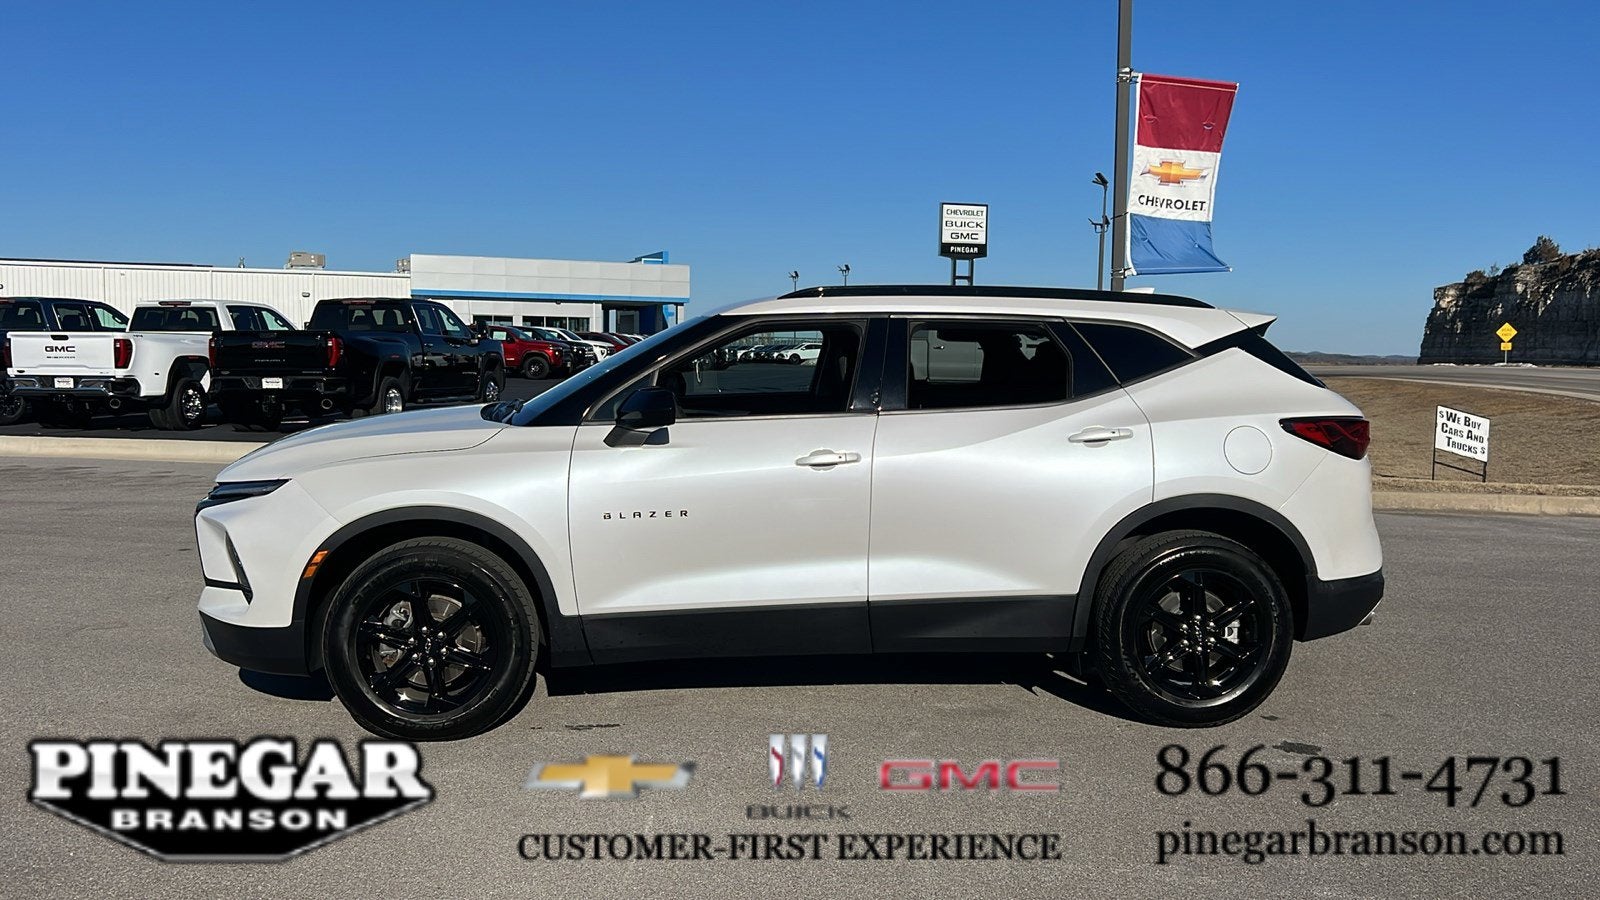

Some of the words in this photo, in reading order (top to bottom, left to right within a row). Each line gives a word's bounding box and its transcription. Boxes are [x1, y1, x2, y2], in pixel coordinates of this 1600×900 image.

[1138, 194, 1206, 212] CHEVROLET
[946, 208, 984, 217] CHEVROLET
[945, 220, 984, 229] BUICK
[950, 232, 979, 240] GMC
[950, 246, 979, 254] PINEGAR
[45, 345, 76, 353] GMC
[1464, 416, 1482, 430] BUY
[1441, 422, 1464, 438] CARS
[1466, 430, 1484, 444] AND
[1446, 436, 1478, 454] TRUCKS
[603, 509, 689, 520] BLAZER
